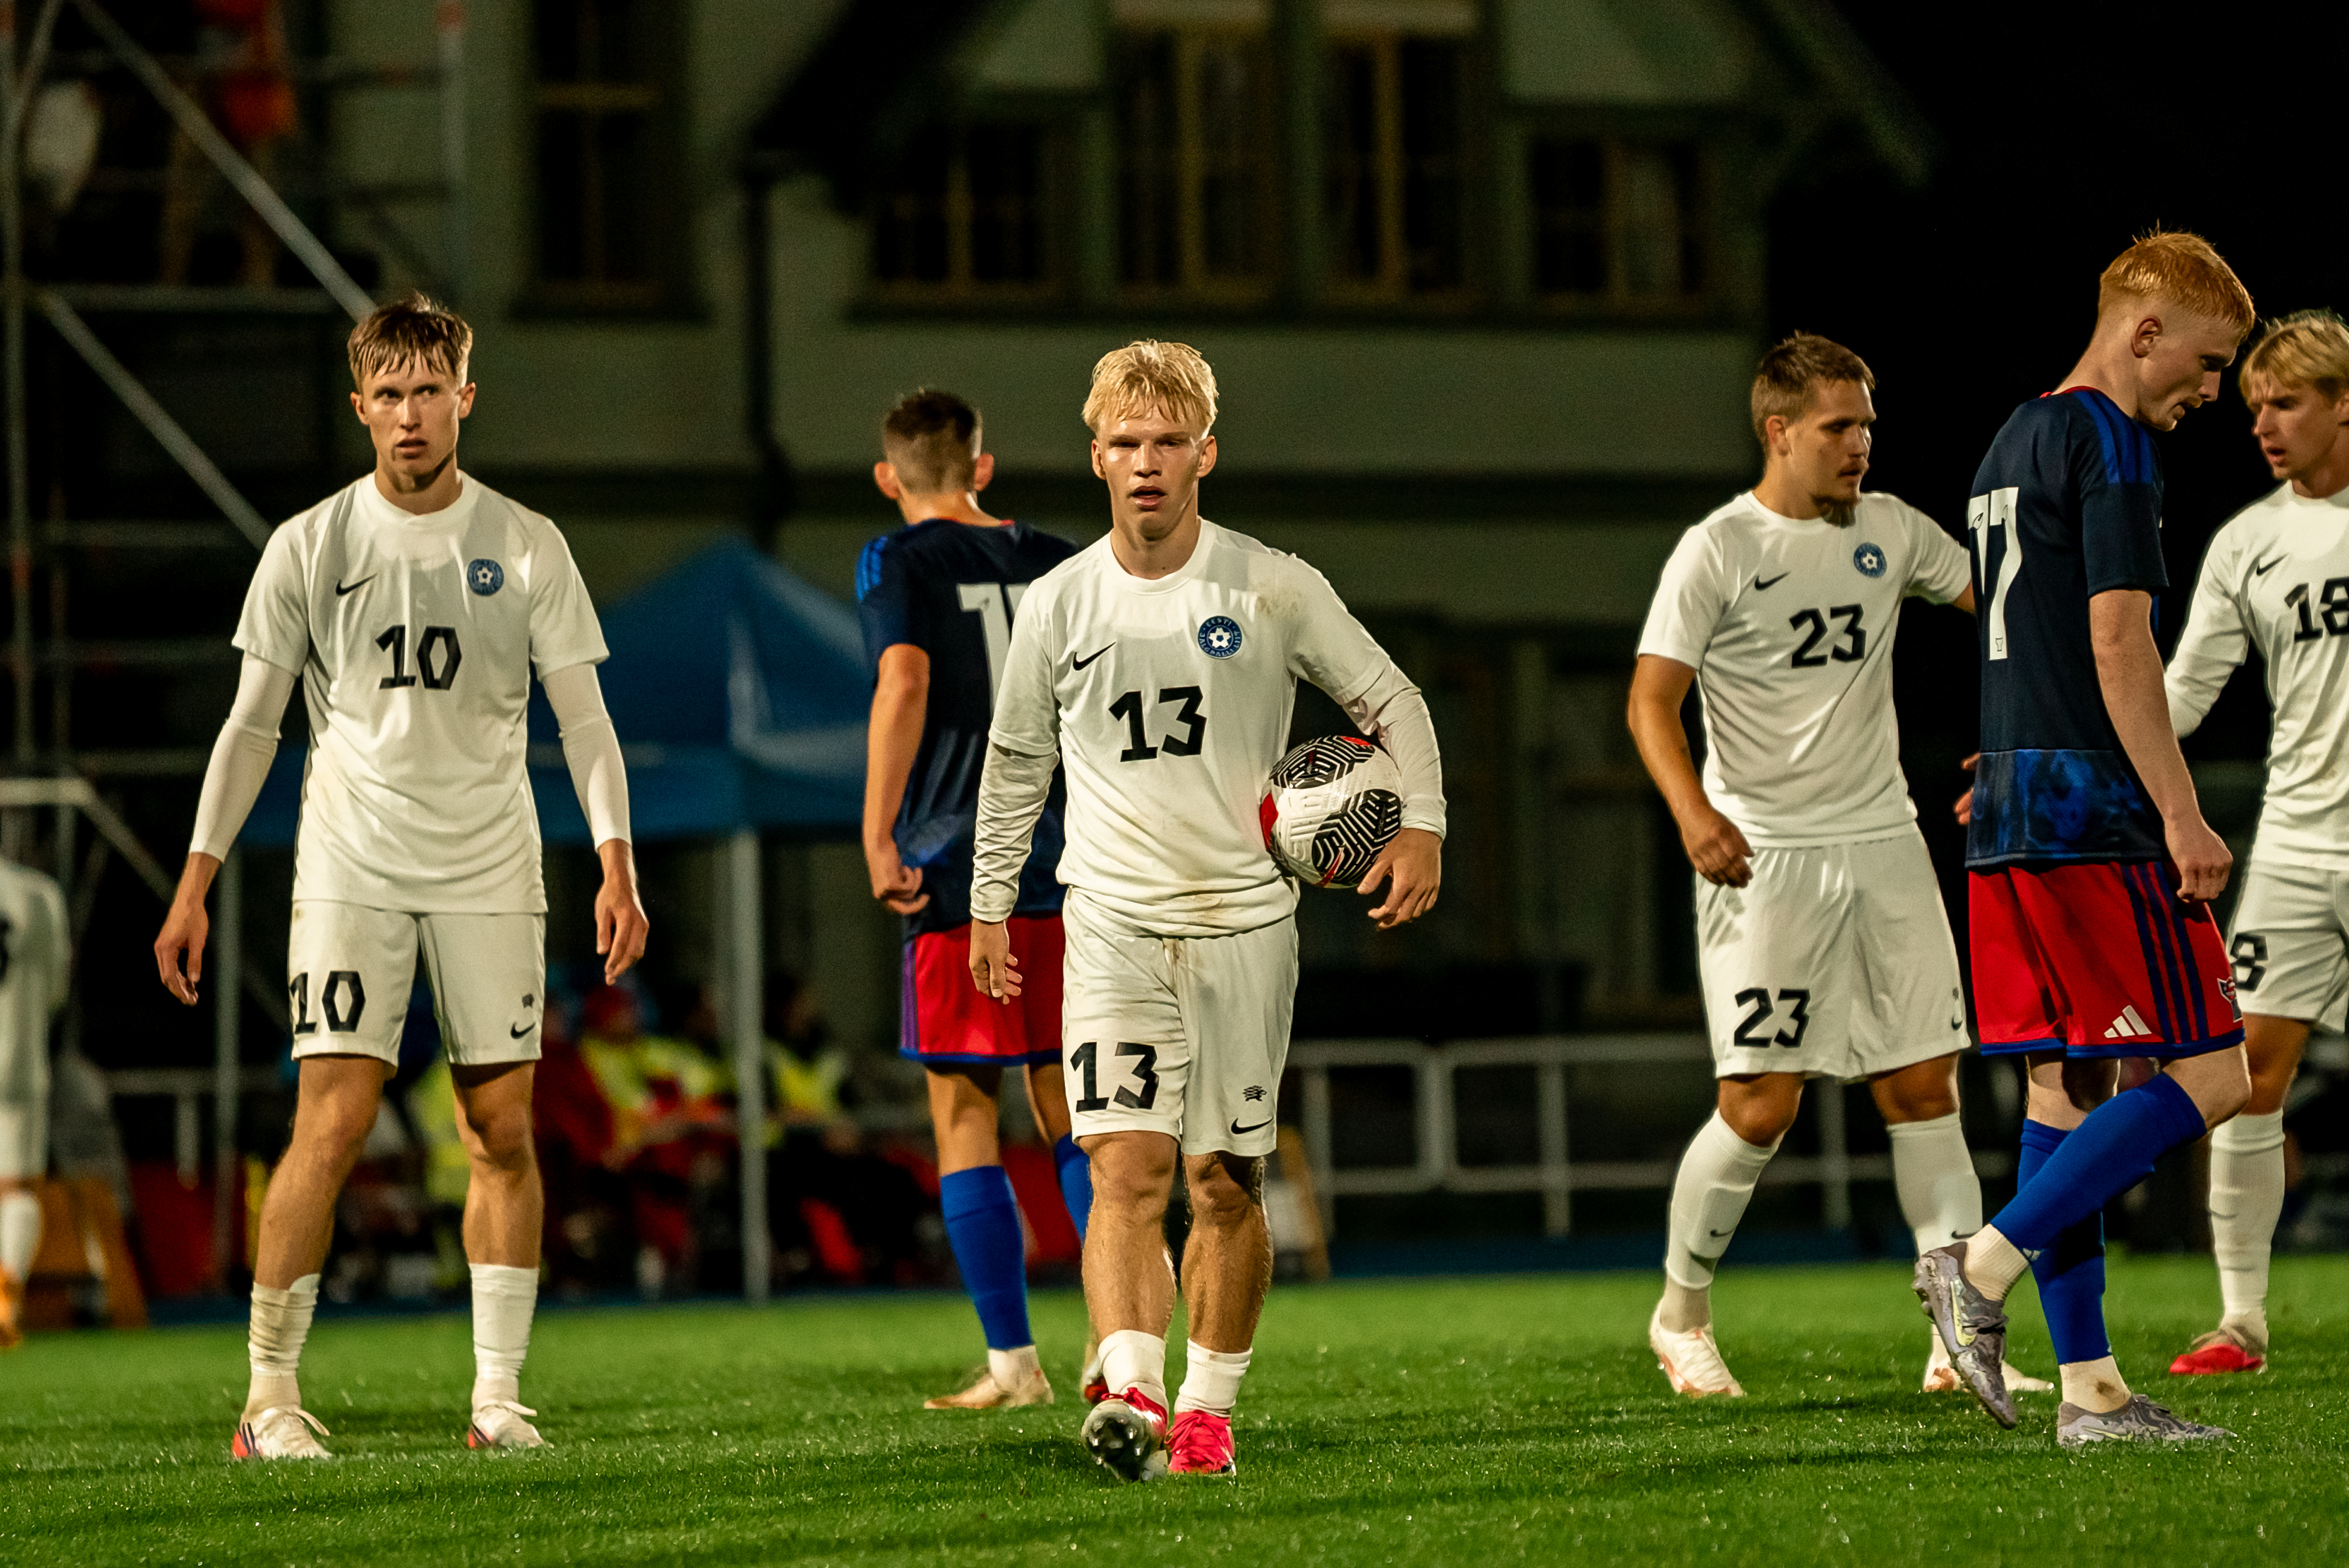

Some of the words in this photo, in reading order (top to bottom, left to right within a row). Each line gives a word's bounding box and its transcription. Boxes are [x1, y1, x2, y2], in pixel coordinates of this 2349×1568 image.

[1205, 617, 1232, 627] EESTI
[1789, 603, 1866, 669] 23
[2284, 576, 2349, 642] 18
[375, 625, 462, 690] 10
[956, 582, 1031, 718] 1
[1199, 632, 1235, 657] JALGPALLI
[1108, 685, 1207, 762] 13
[289, 971, 366, 1034] 10
[1734, 988, 1811, 1048] 23
[1070, 1042, 1159, 1112] 13
